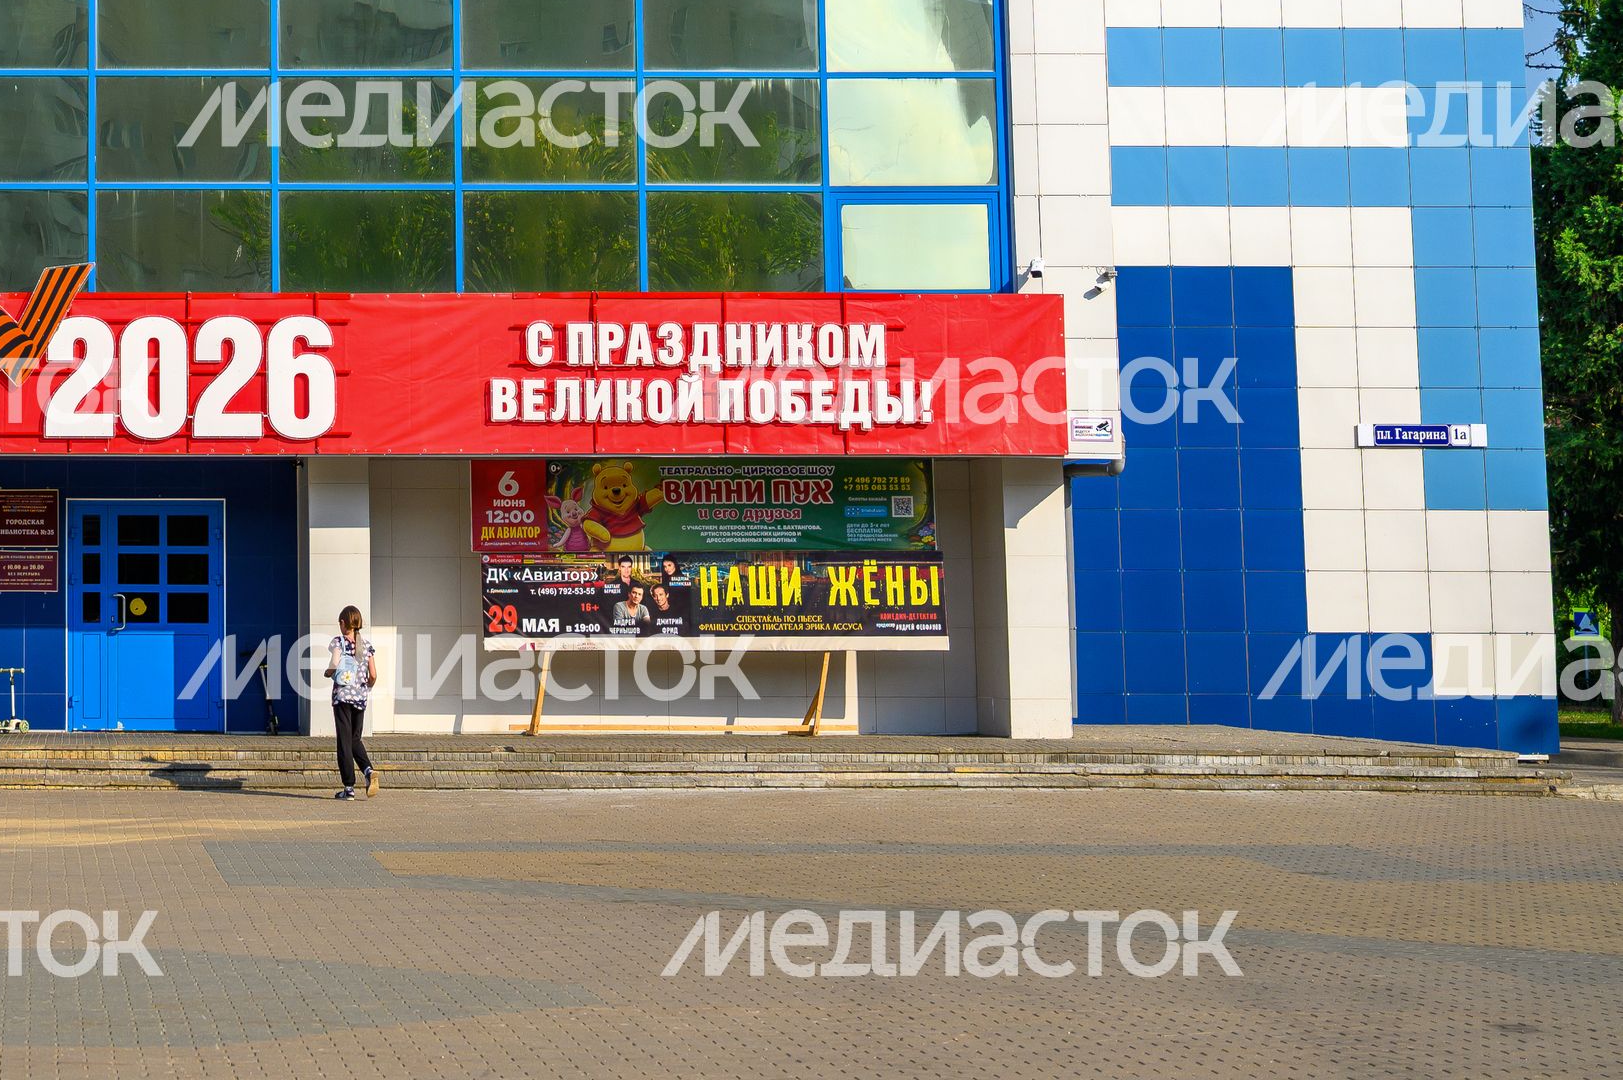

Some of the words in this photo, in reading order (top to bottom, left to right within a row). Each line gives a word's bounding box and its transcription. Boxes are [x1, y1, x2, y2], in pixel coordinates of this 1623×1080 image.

[526, 321, 553, 367] С
[568, 322, 887, 373] ПРАЗДНИКОМ
[44, 316, 336, 440] 2026
[489, 375, 718, 424] ВЕЛИКОЙ
[720, 378, 935, 431] ПОБЕДЫ!
[1377, 430, 1393, 440] пл.
[1395, 428, 1446, 442] Гагарина
[1454, 428, 1466, 440] 1а
[551, 464, 560, 472] 0+
[659, 466, 733, 476] ТЕАТРАЛЬНО
[742, 466, 806, 476] ЦИРКОВОЕ
[808, 466, 835, 476] ШОУ
[498, 471, 519, 497] 6
[663, 479, 765, 504] ВИННИ
[772, 479, 834, 504] ПУХ
[493, 499, 525, 507] ИЮНЯ
[486, 510, 534, 523] 12:00
[698, 509, 709, 519] и
[713, 509, 738, 519] его
[743, 509, 801, 522] друзья
[481, 527, 495, 540] ДК
[498, 527, 540, 538] АВИАТОР
[487, 568, 508, 583] ДК
[513, 568, 598, 583] «Авиатор»
[700, 566, 802, 606] НАШИ
[827, 560, 940, 606] ЖЁНЫ
[538, 588, 557, 596] (496)
[581, 603, 599, 611] 16+
[489, 605, 517, 632] 29
[522, 619, 559, 632] МАЯ
[574, 624, 600, 632] 19:00
[657, 617, 682, 625] ДМИТРИЙ
